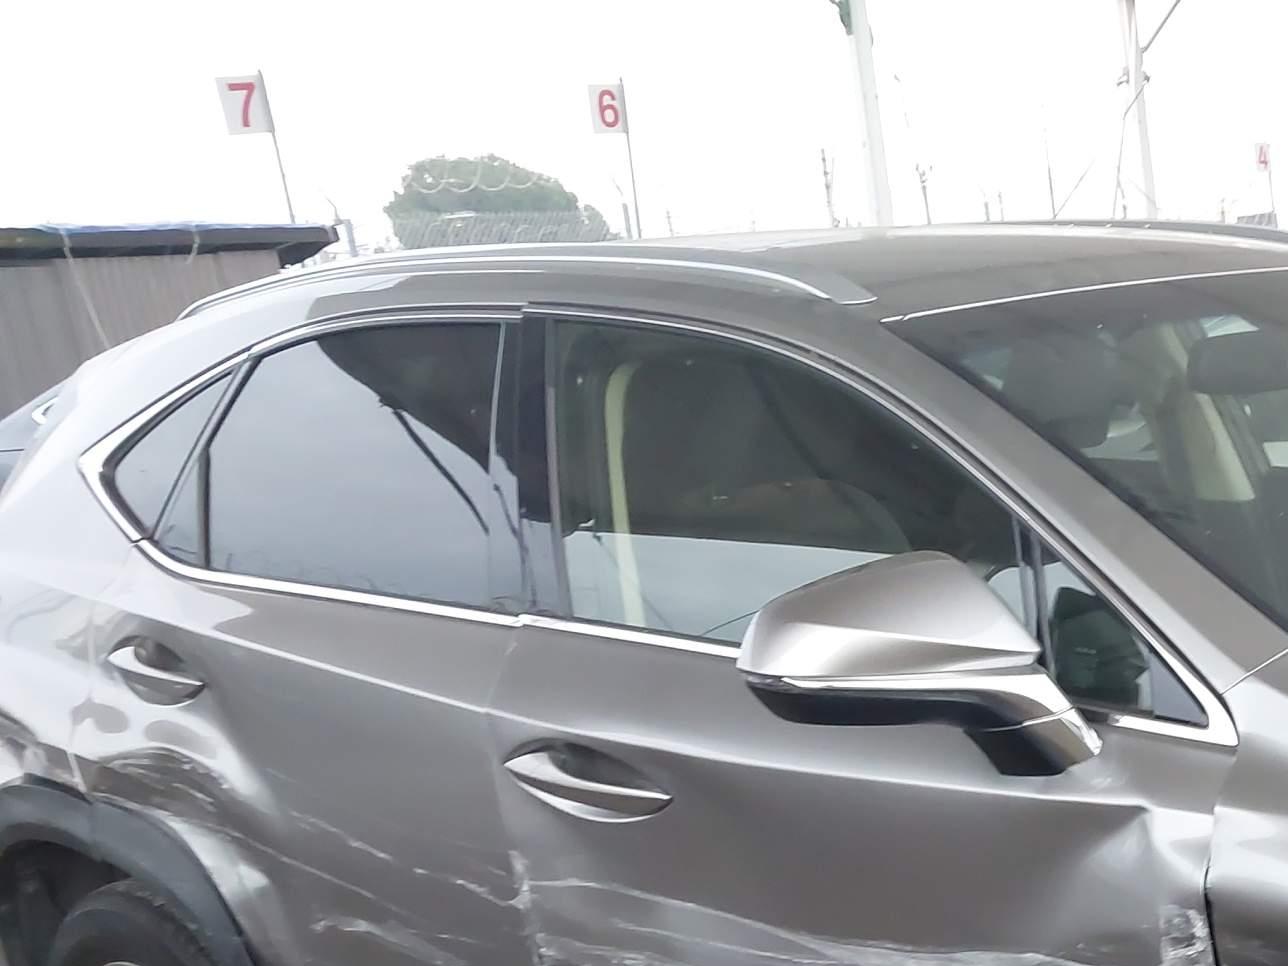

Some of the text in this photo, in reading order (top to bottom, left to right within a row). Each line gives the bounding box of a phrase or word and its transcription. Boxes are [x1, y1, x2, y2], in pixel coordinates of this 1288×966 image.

[227, 82, 256, 128] 7
[598, 89, 620, 129] 6
[1258, 144, 1268, 170] 4
